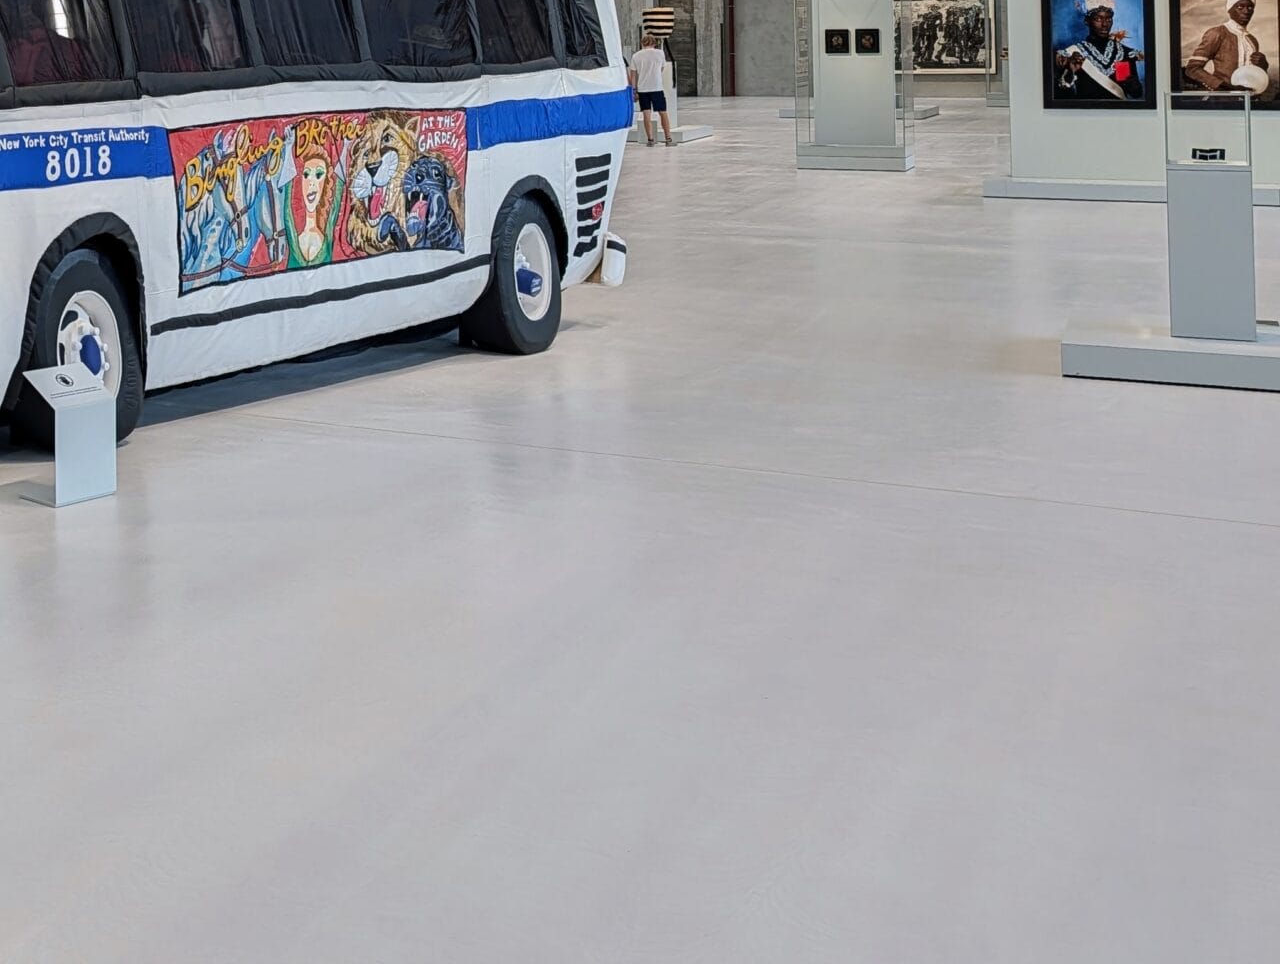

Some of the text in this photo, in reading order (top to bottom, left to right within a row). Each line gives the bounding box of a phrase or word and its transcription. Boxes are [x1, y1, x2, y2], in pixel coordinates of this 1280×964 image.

[422, 115, 456, 131] AT THE
[22, 136, 46, 148] York
[49, 134, 68, 149] City
[71, 130, 106, 144] Transit
[108, 128, 149, 144] Authority
[418, 131, 458, 153] GARDEN
[45, 145, 111, 182] 8018
